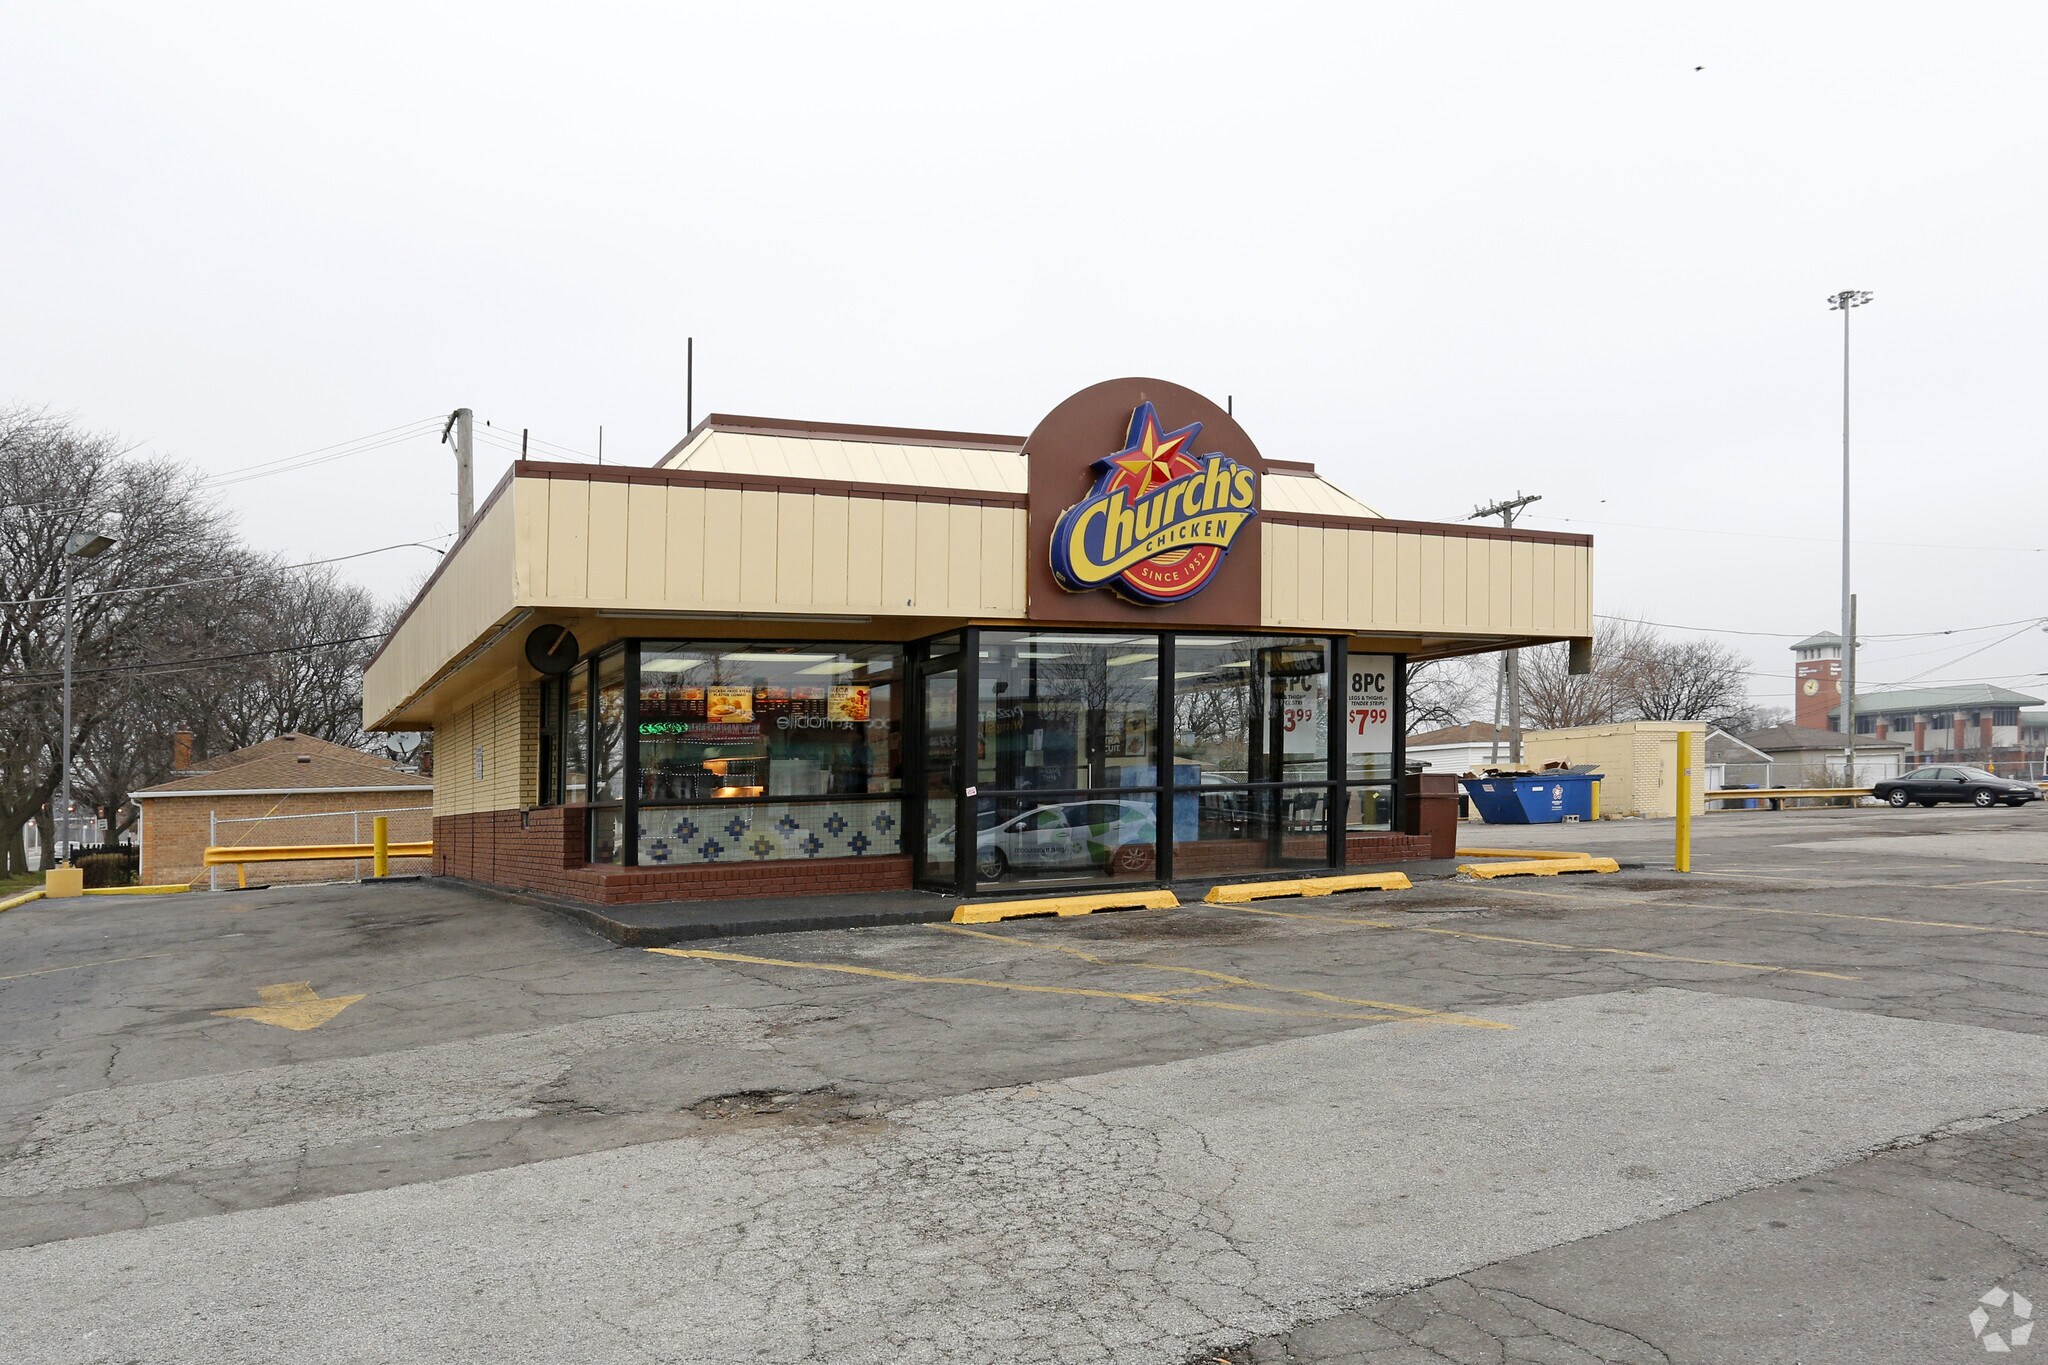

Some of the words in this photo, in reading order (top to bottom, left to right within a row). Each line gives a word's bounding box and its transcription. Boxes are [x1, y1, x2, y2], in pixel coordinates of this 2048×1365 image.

[1069, 457, 1255, 583] Church's
[1146, 520, 1228, 552] CHICKEN
[1142, 567, 1180, 582] SINCE
[1184, 551, 1206, 576] 1952
[1351, 672, 1386, 693] 8PC
